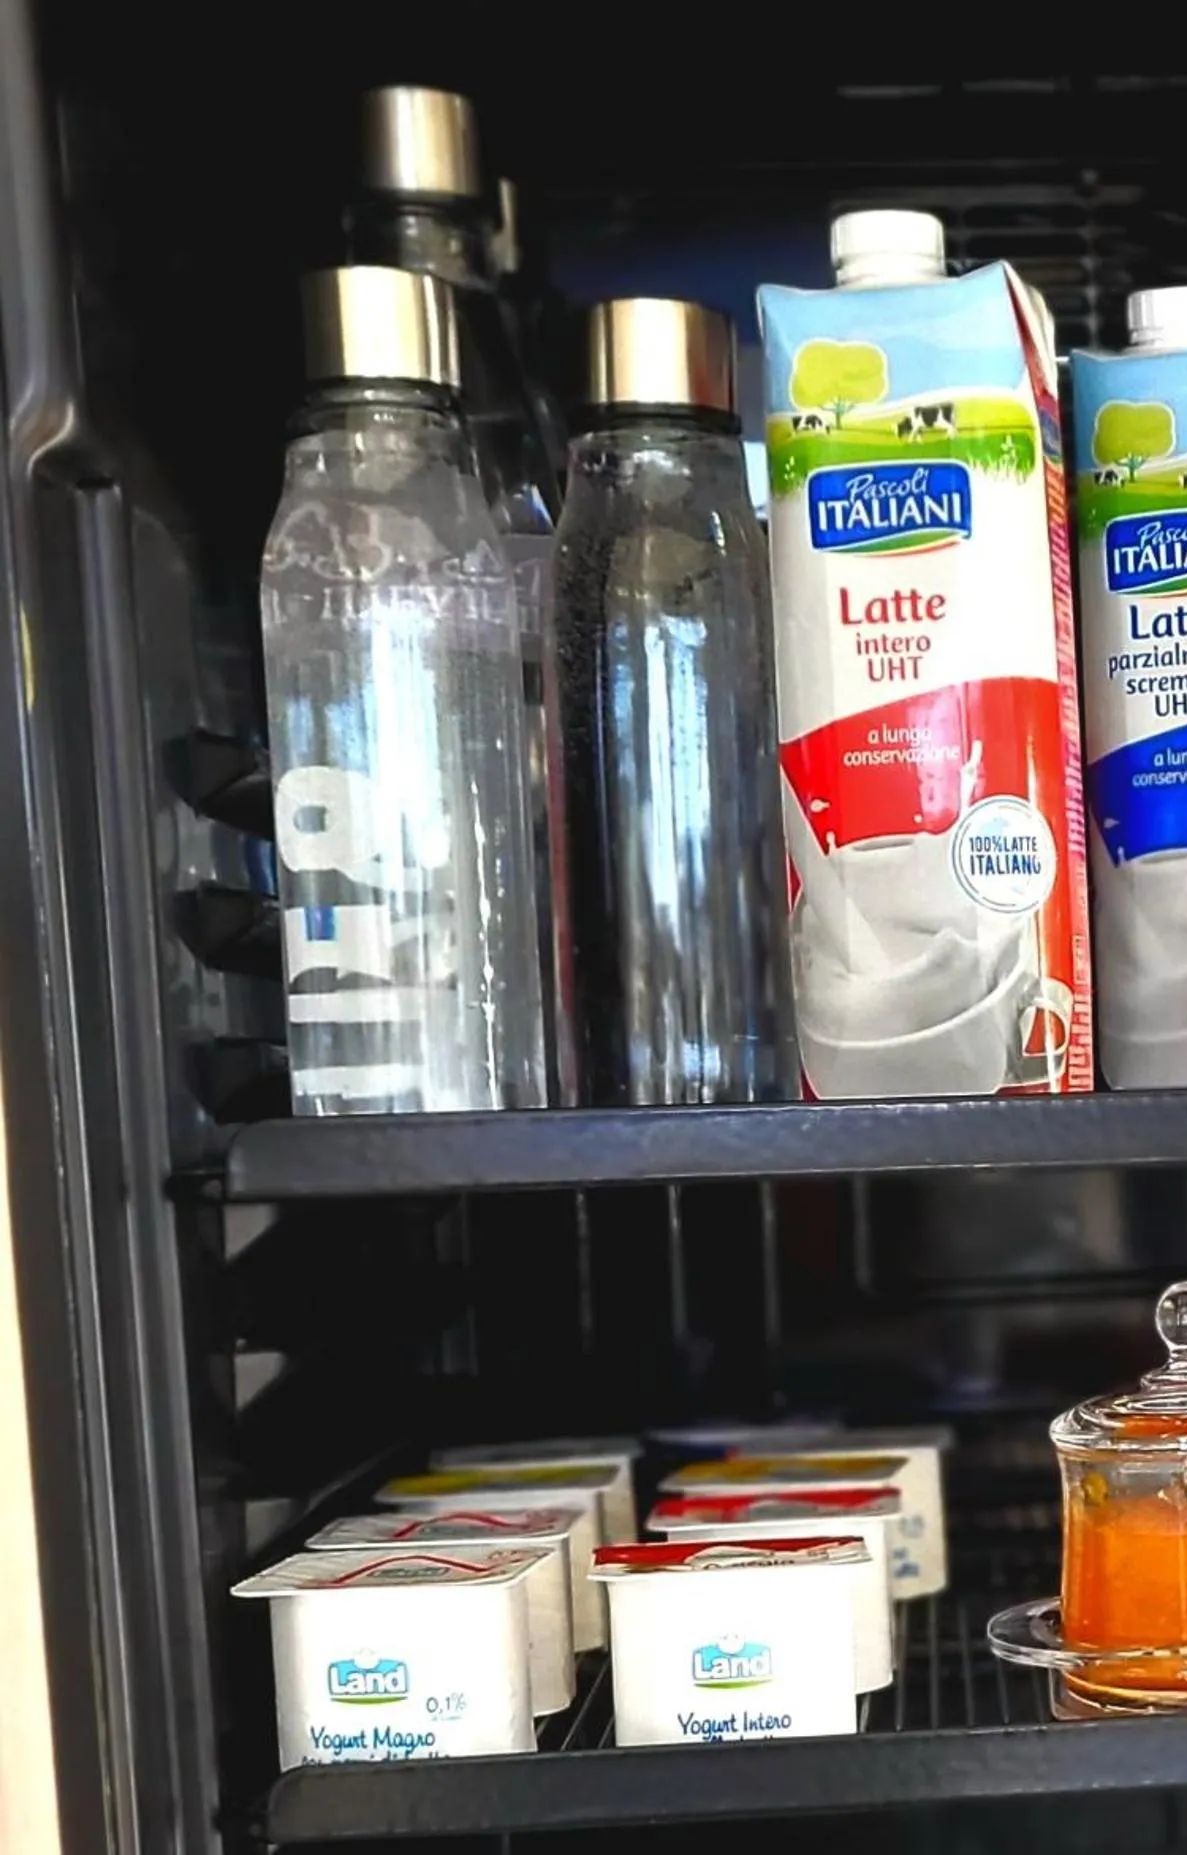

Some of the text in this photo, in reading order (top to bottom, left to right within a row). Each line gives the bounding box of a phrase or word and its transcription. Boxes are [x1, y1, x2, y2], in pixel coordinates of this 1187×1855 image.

[846, 467, 929, 501] Pascoli
[817, 493, 962, 531] ITALIANI
[839, 586, 947, 626] Latte
[856, 632, 932, 656] intero
[867, 656, 924, 682] UHT
[868, 722, 932, 748] a lunga
[1153, 753, 1165, 768] a
[969, 854, 1042, 876] ITALIANO
[693, 1646, 773, 1681] Land
[329, 1662, 409, 1697] Land
[310, 1725, 437, 1756] Yogurt Magro
[677, 1709, 792, 1741] Yogurt Intero
